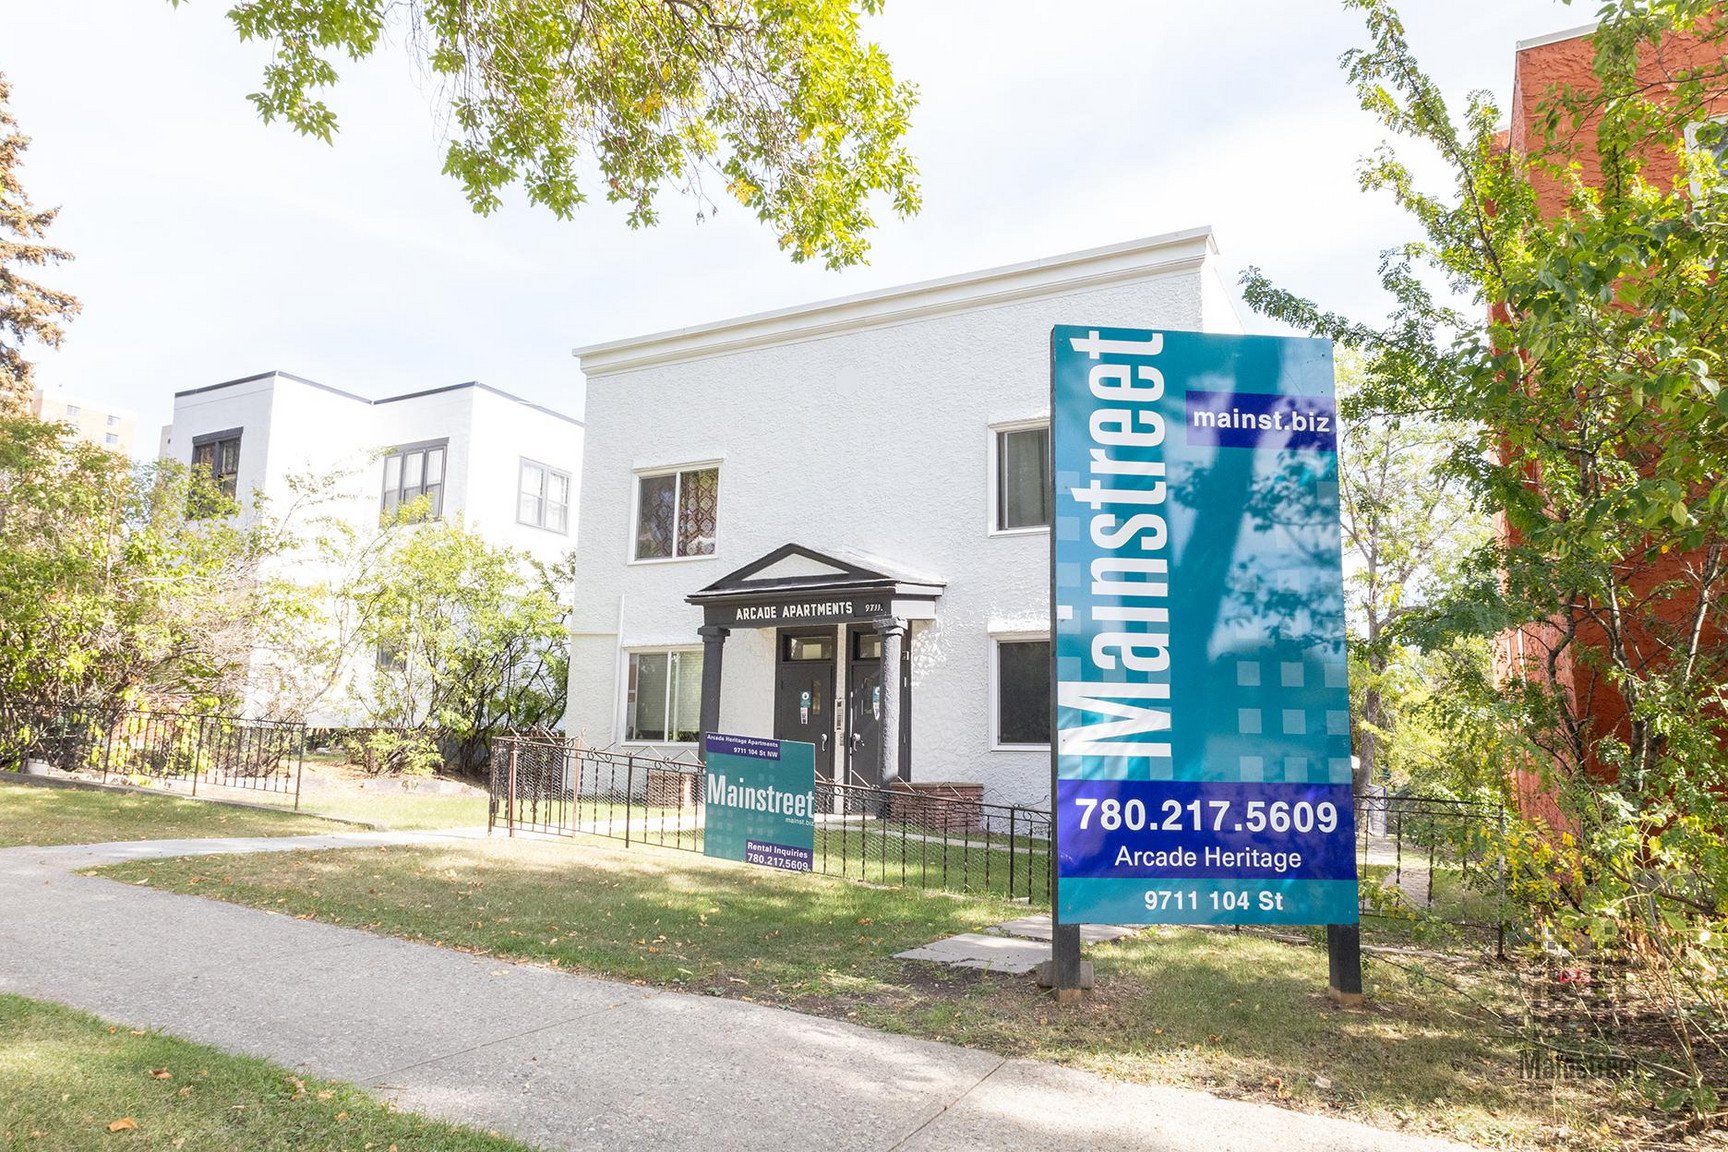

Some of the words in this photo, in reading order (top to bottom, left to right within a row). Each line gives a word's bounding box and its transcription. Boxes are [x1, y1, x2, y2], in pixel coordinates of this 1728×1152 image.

[1193, 408, 1331, 434] mainst.biz
[1058, 330, 1173, 760] Mainstreet
[736, 605, 777, 621] ARCADE
[782, 601, 853, 618] APARTMENTS
[707, 734, 725, 742] Arcade
[725, 735, 747, 745] Heritage
[747, 738, 779, 748] Apartments
[733, 747, 747, 755] 9711
[748, 748, 758, 756] 104
[759, 749, 766, 757] St
[767, 750, 778, 758] NW
[707, 773, 815, 819] Mainstreet
[1075, 798, 1338, 833] 780.217.5609
[747, 842, 772, 854] Rental
[773, 846, 809, 859] Inquiries
[1114, 845, 1197, 868] Arcade
[1205, 846, 1302, 872] Heritage
[747, 853, 809, 871] 780.217.5609
[1144, 891, 1198, 910] 9711
[1209, 891, 1250, 910] 104
[1258, 891, 1284, 911] St
